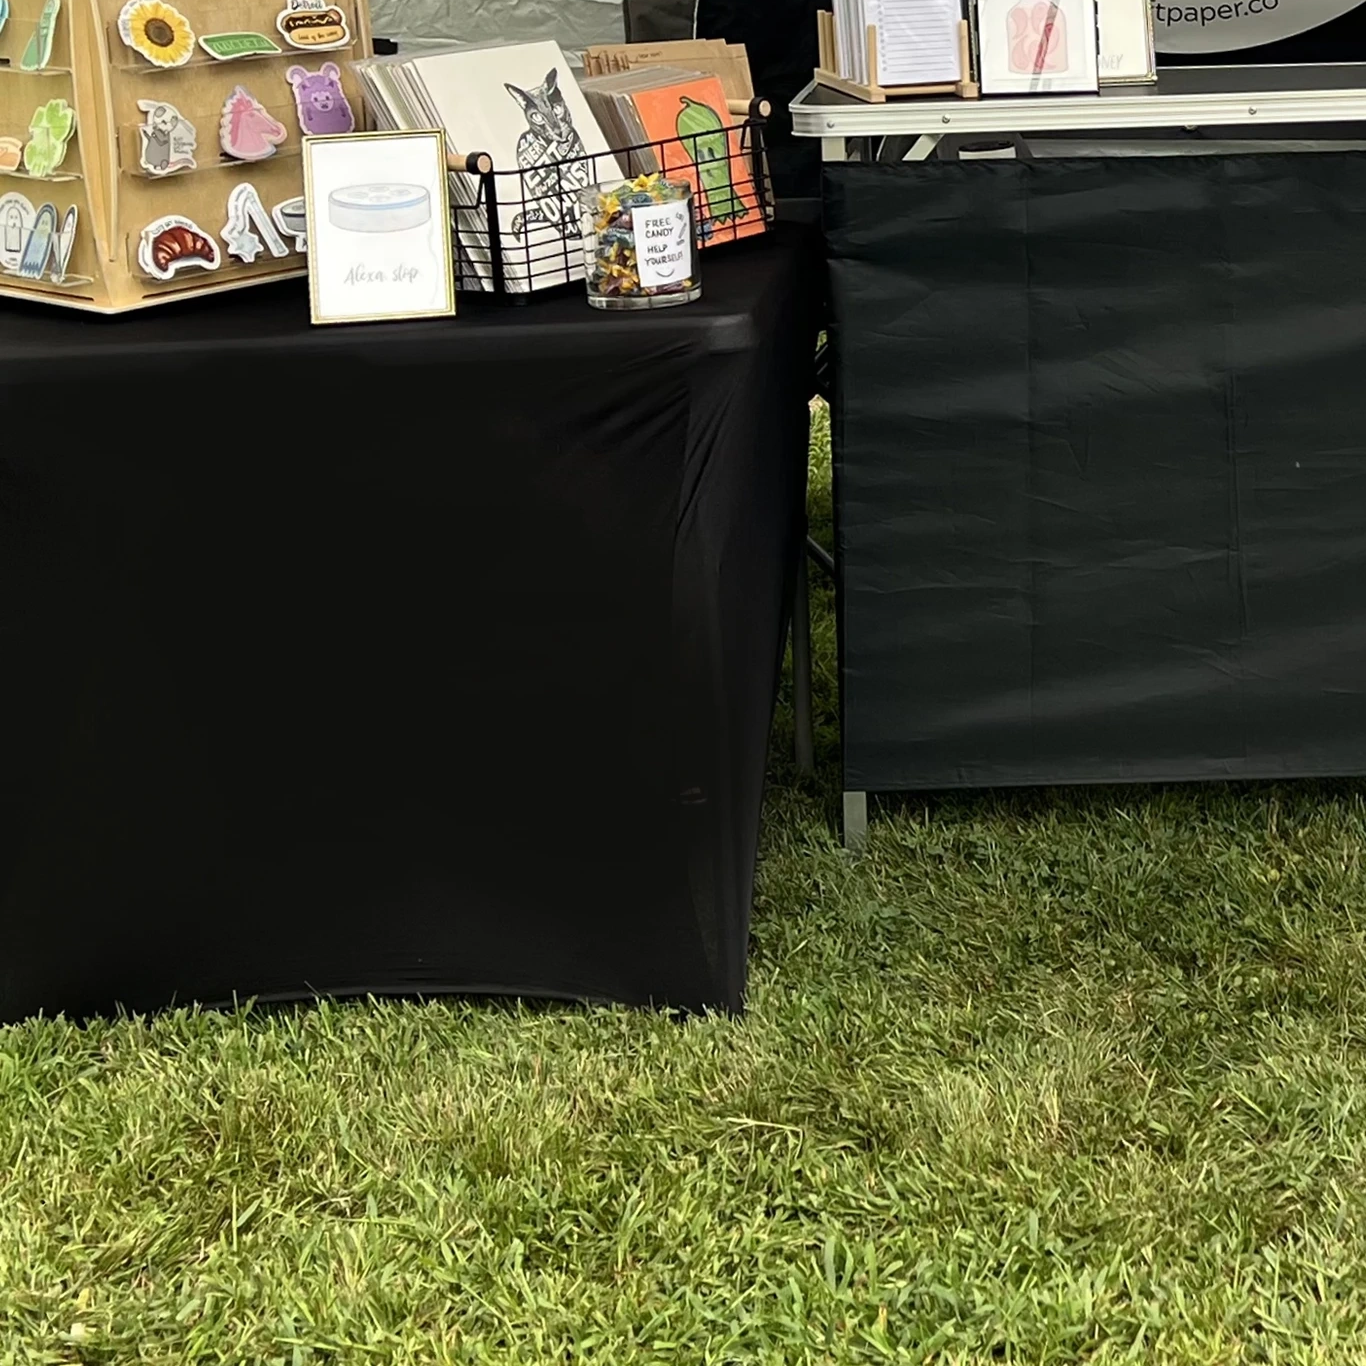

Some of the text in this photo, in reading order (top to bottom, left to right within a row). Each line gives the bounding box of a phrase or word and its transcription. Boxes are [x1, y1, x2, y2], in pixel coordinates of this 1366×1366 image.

[645, 217, 672, 229] FREE
[645, 227, 674, 239] CANDY
[647, 244, 668, 254] HELP
